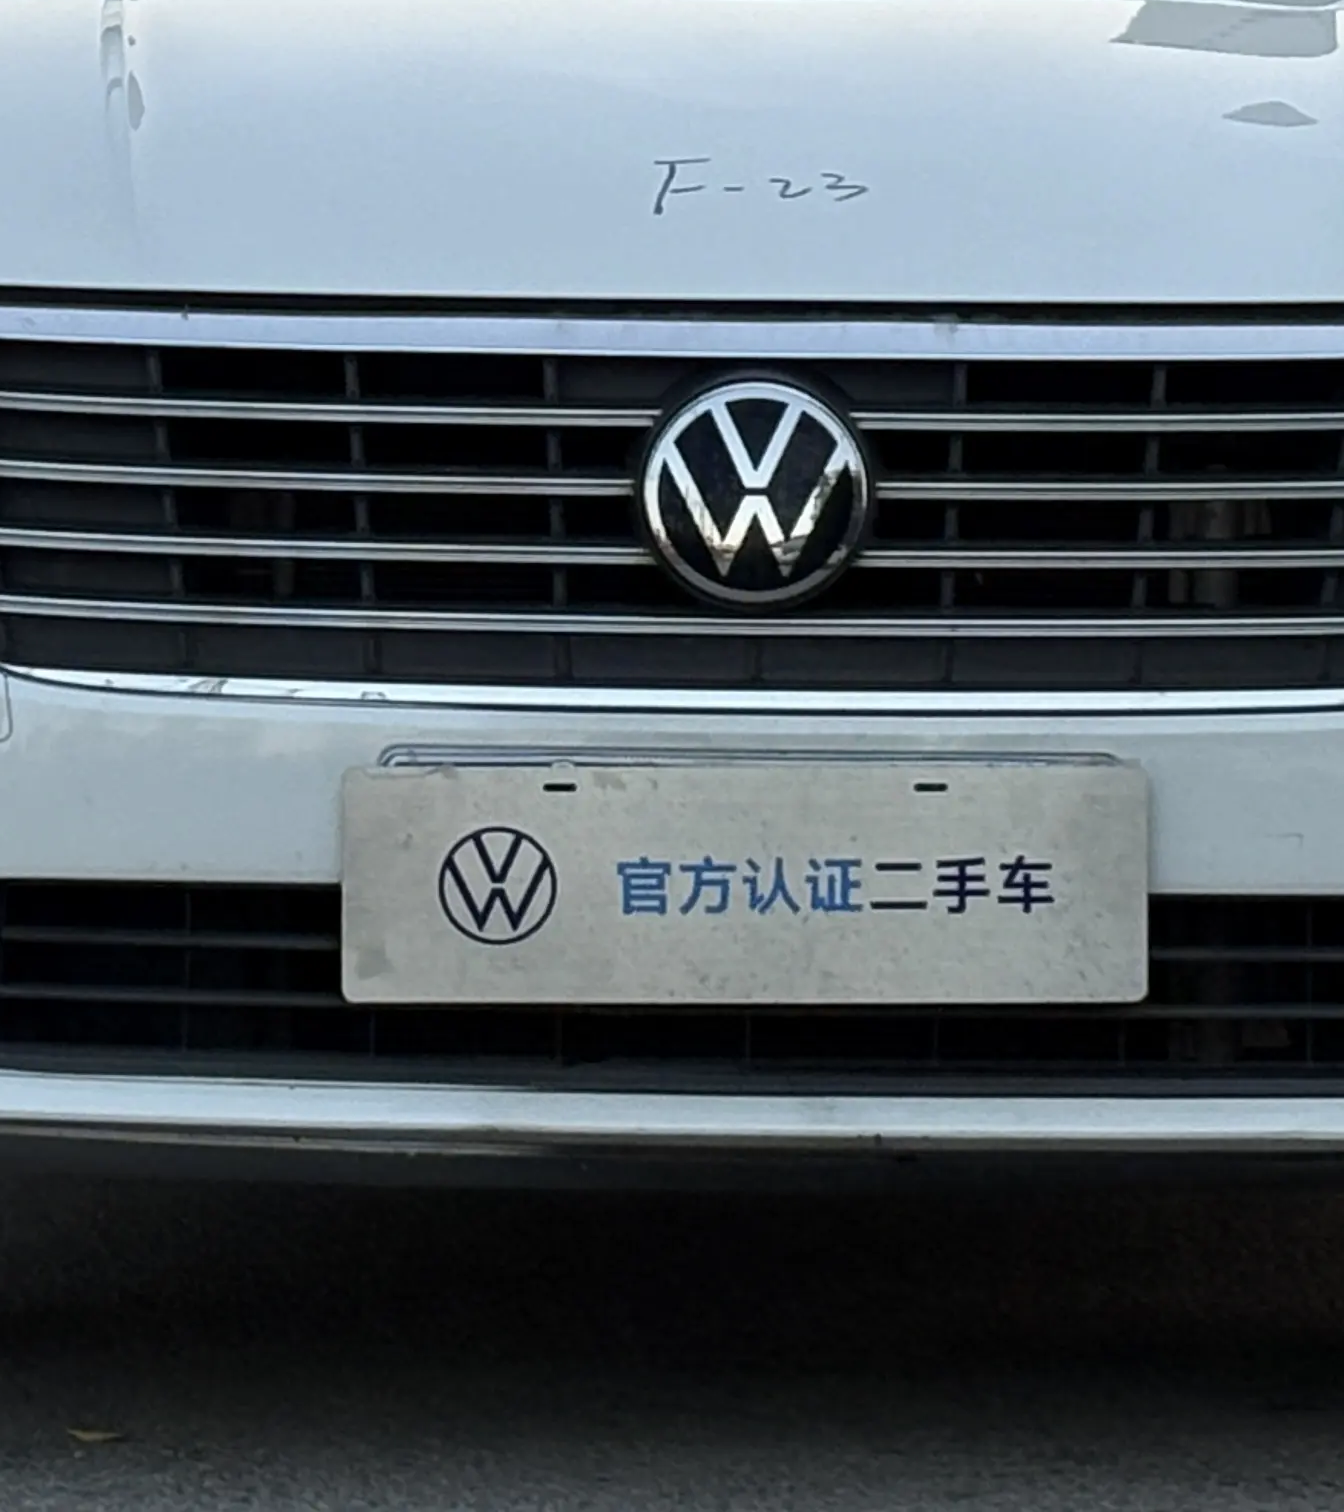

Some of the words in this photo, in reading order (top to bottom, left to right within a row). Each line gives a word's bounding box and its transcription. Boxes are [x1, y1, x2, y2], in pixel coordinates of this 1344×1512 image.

[652, 157, 869, 216] F-23
[656, 392, 854, 582] VW
[443, 829, 553, 934] VW
[615, 854, 1055, 916] 官方认证二手车
